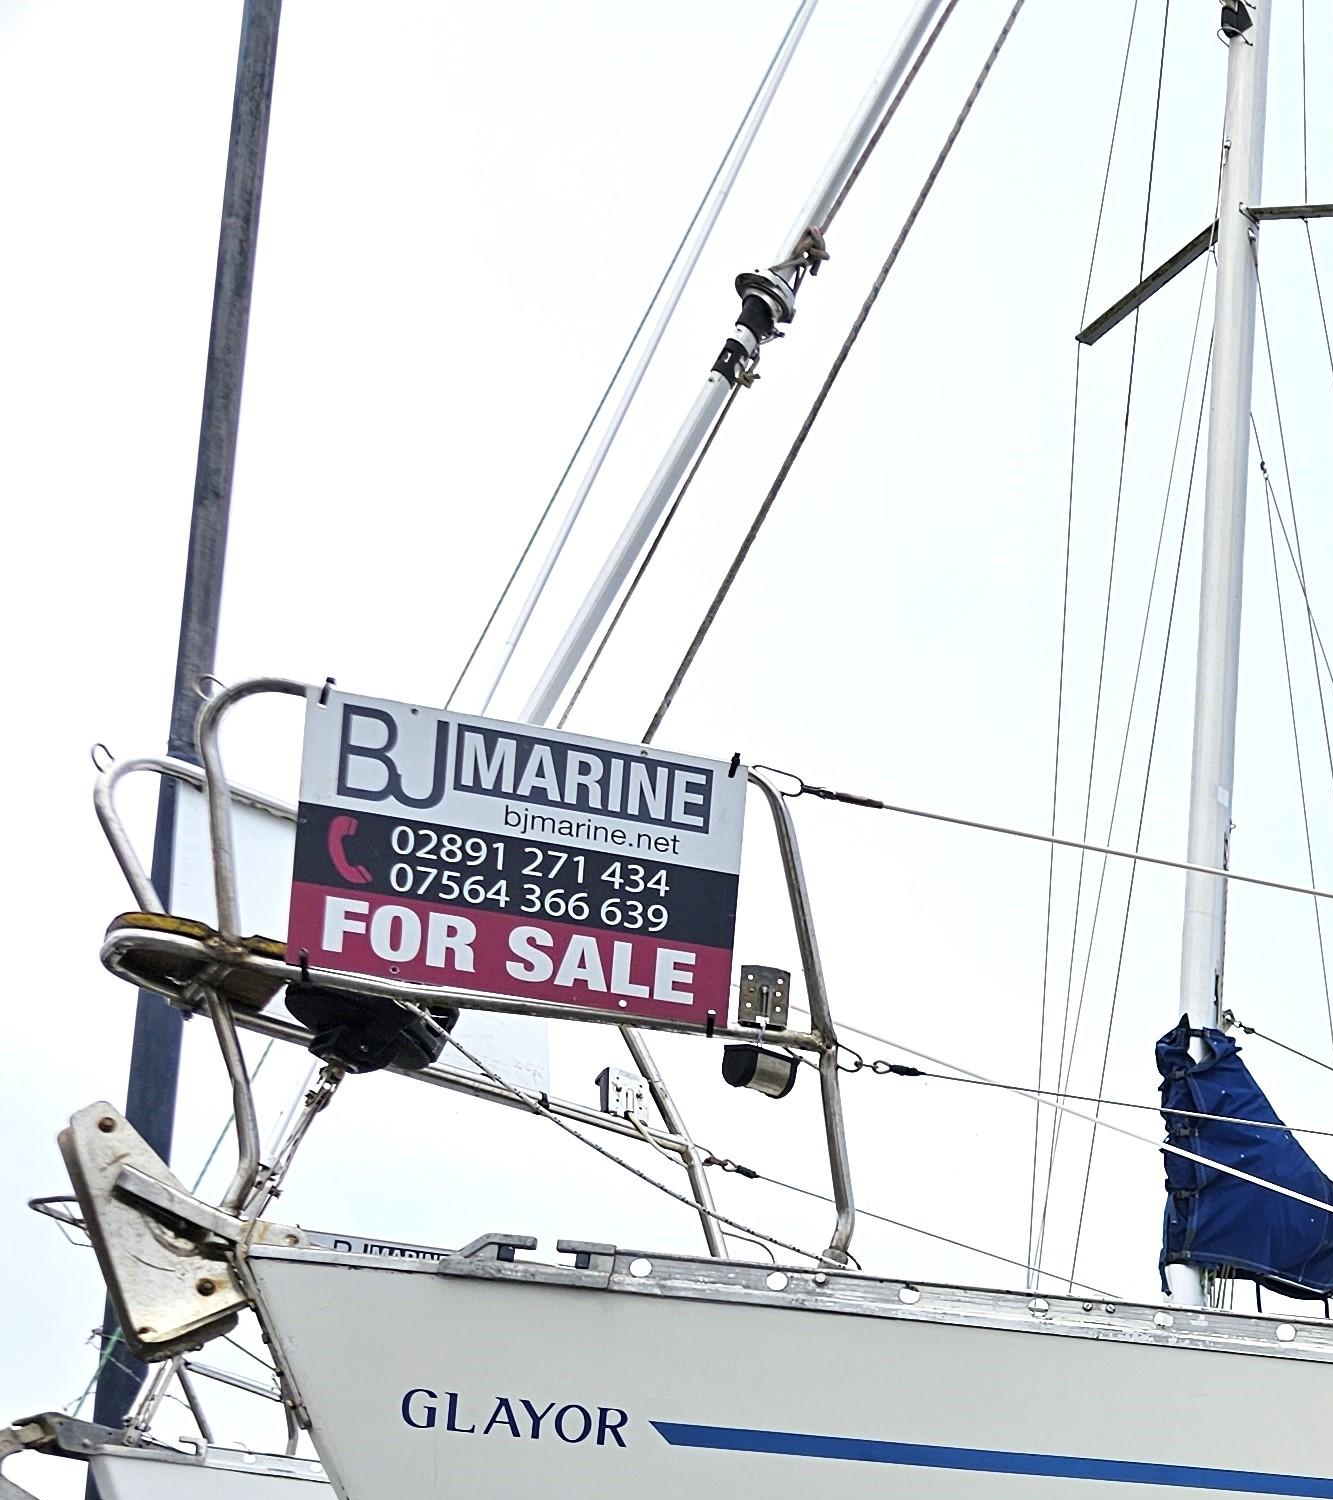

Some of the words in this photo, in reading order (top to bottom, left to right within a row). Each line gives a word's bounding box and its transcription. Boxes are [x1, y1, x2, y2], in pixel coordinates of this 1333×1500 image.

[337, 703, 449, 809] BJ
[460, 731, 707, 826] MARINE
[391, 825, 505, 871] 02891
[523, 847, 586, 884] 271
[601, 864, 670, 897] 434
[505, 805, 680, 855] bjmarine.net
[389, 863, 510, 908] 07564
[521, 883, 590, 921] 366
[600, 897, 669, 932] 639
[321, 895, 477, 974] FOR
[505, 926, 697, 1006] SALE
[401, 1388, 629, 1448] GLAYOR
